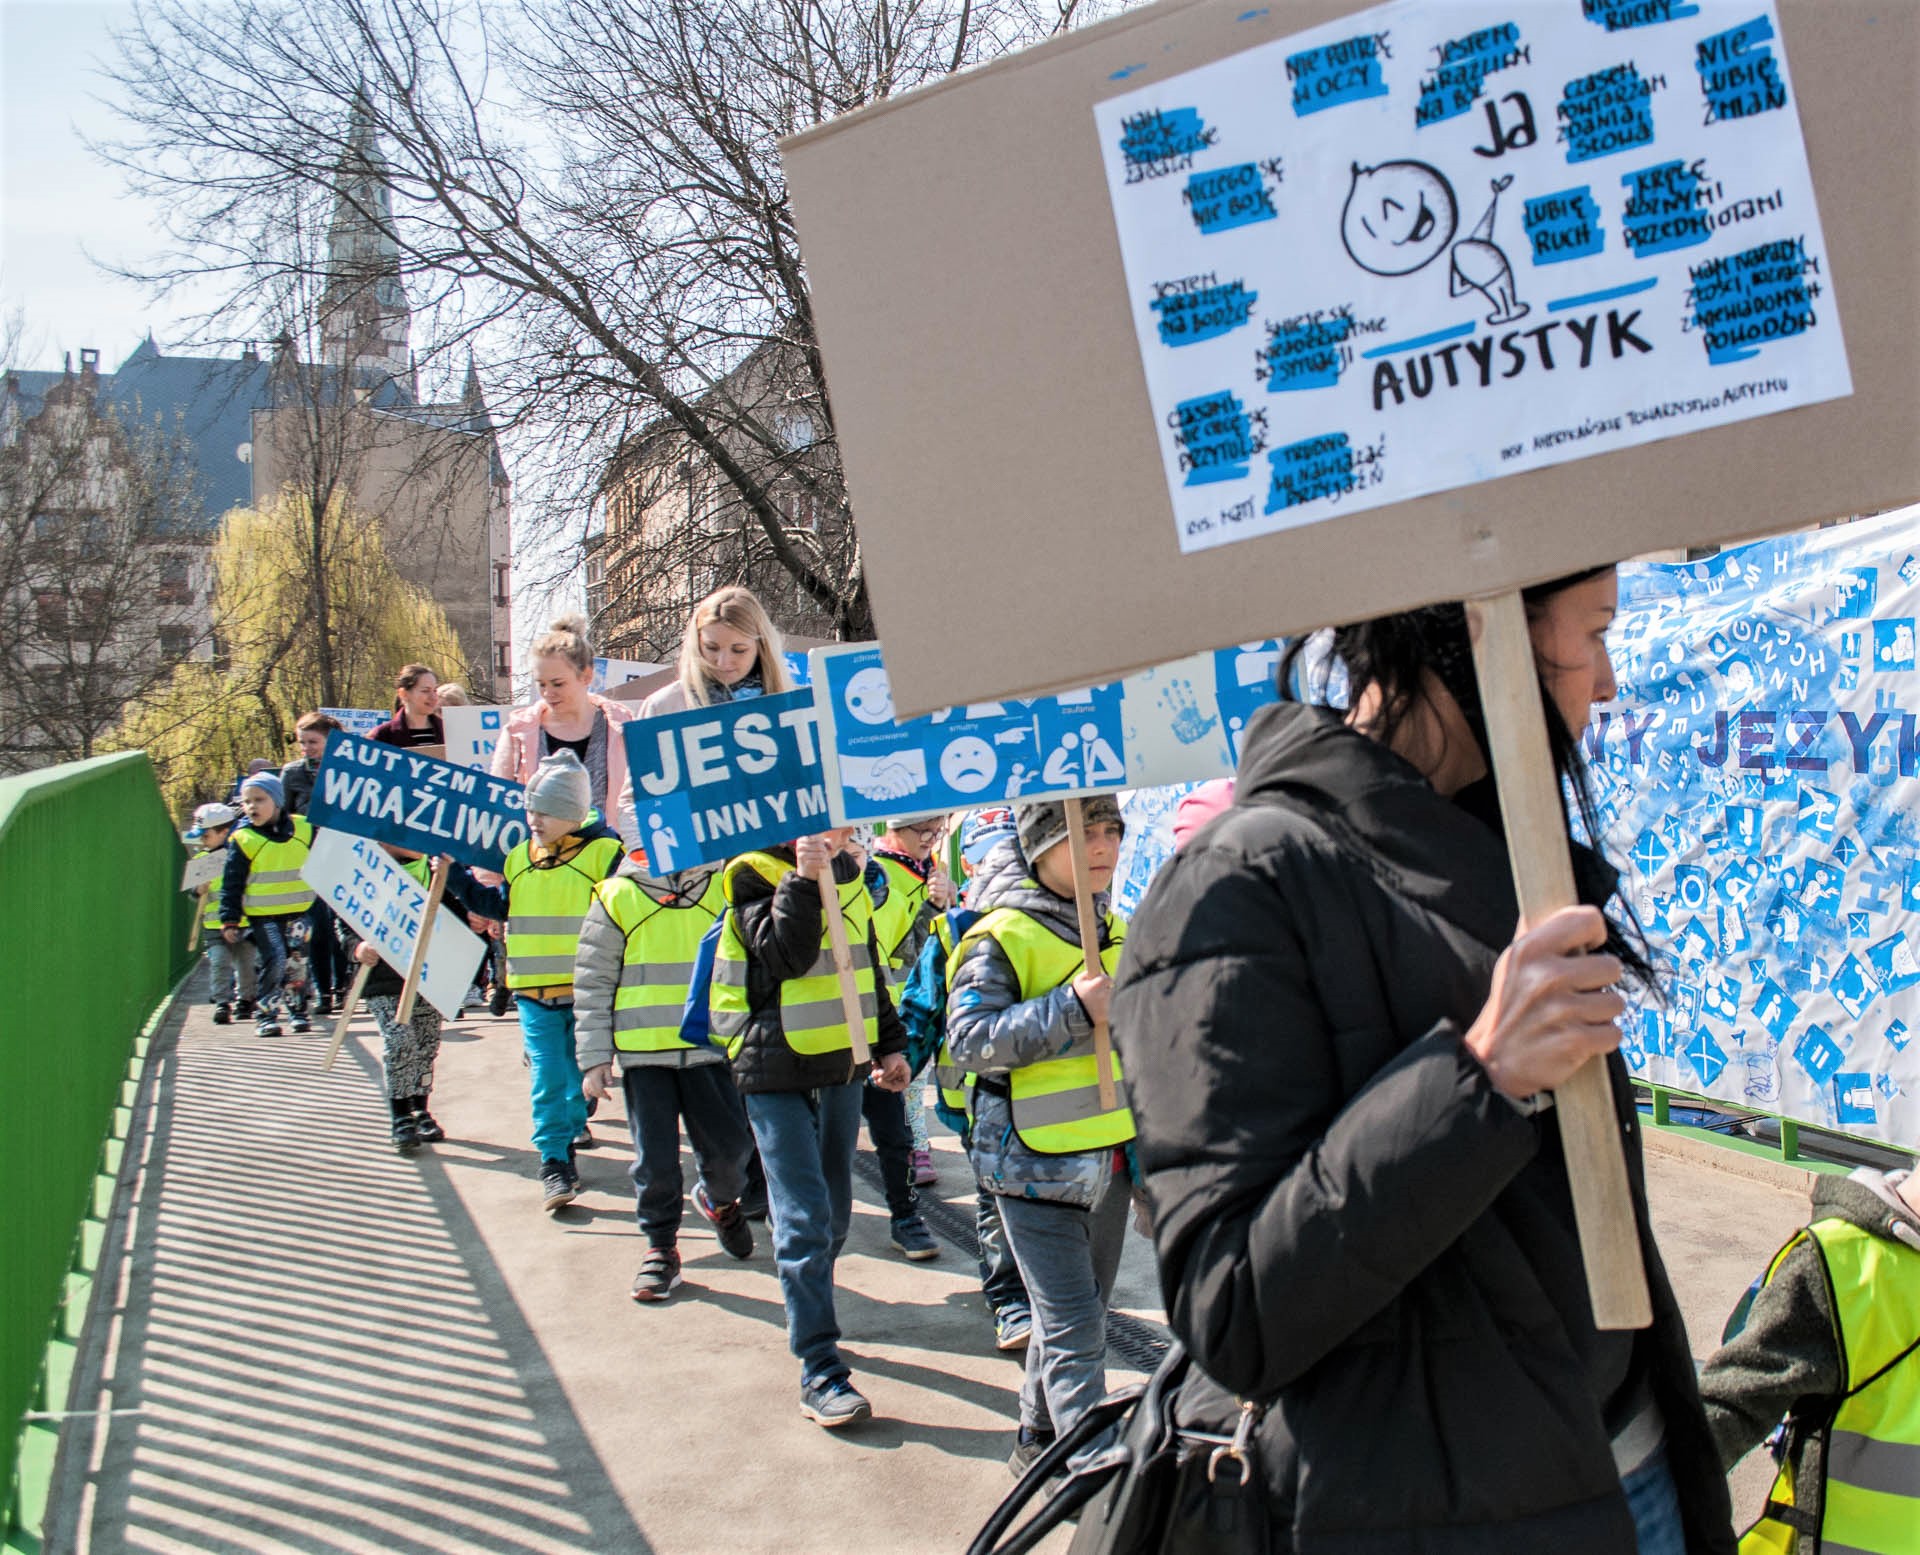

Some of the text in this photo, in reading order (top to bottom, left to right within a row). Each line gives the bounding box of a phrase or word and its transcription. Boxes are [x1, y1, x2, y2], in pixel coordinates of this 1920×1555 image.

[1696, 30, 1748, 67] NIE
[1700, 56, 1776, 95] LUBIĘ
[1702, 83, 1787, 127] ZMIAN
[1535, 222, 1592, 256] RUCH
[1372, 308, 1654, 411] AUTYSTYK
[333, 739, 527, 810] AUTYZM TO
[641, 706, 818, 797] JEST
[324, 768, 528, 856] WRAŻLIWO
[692, 784, 828, 844] INNYM
[352, 840, 442, 933] AUTYZ
[353, 868, 376, 900] TO
